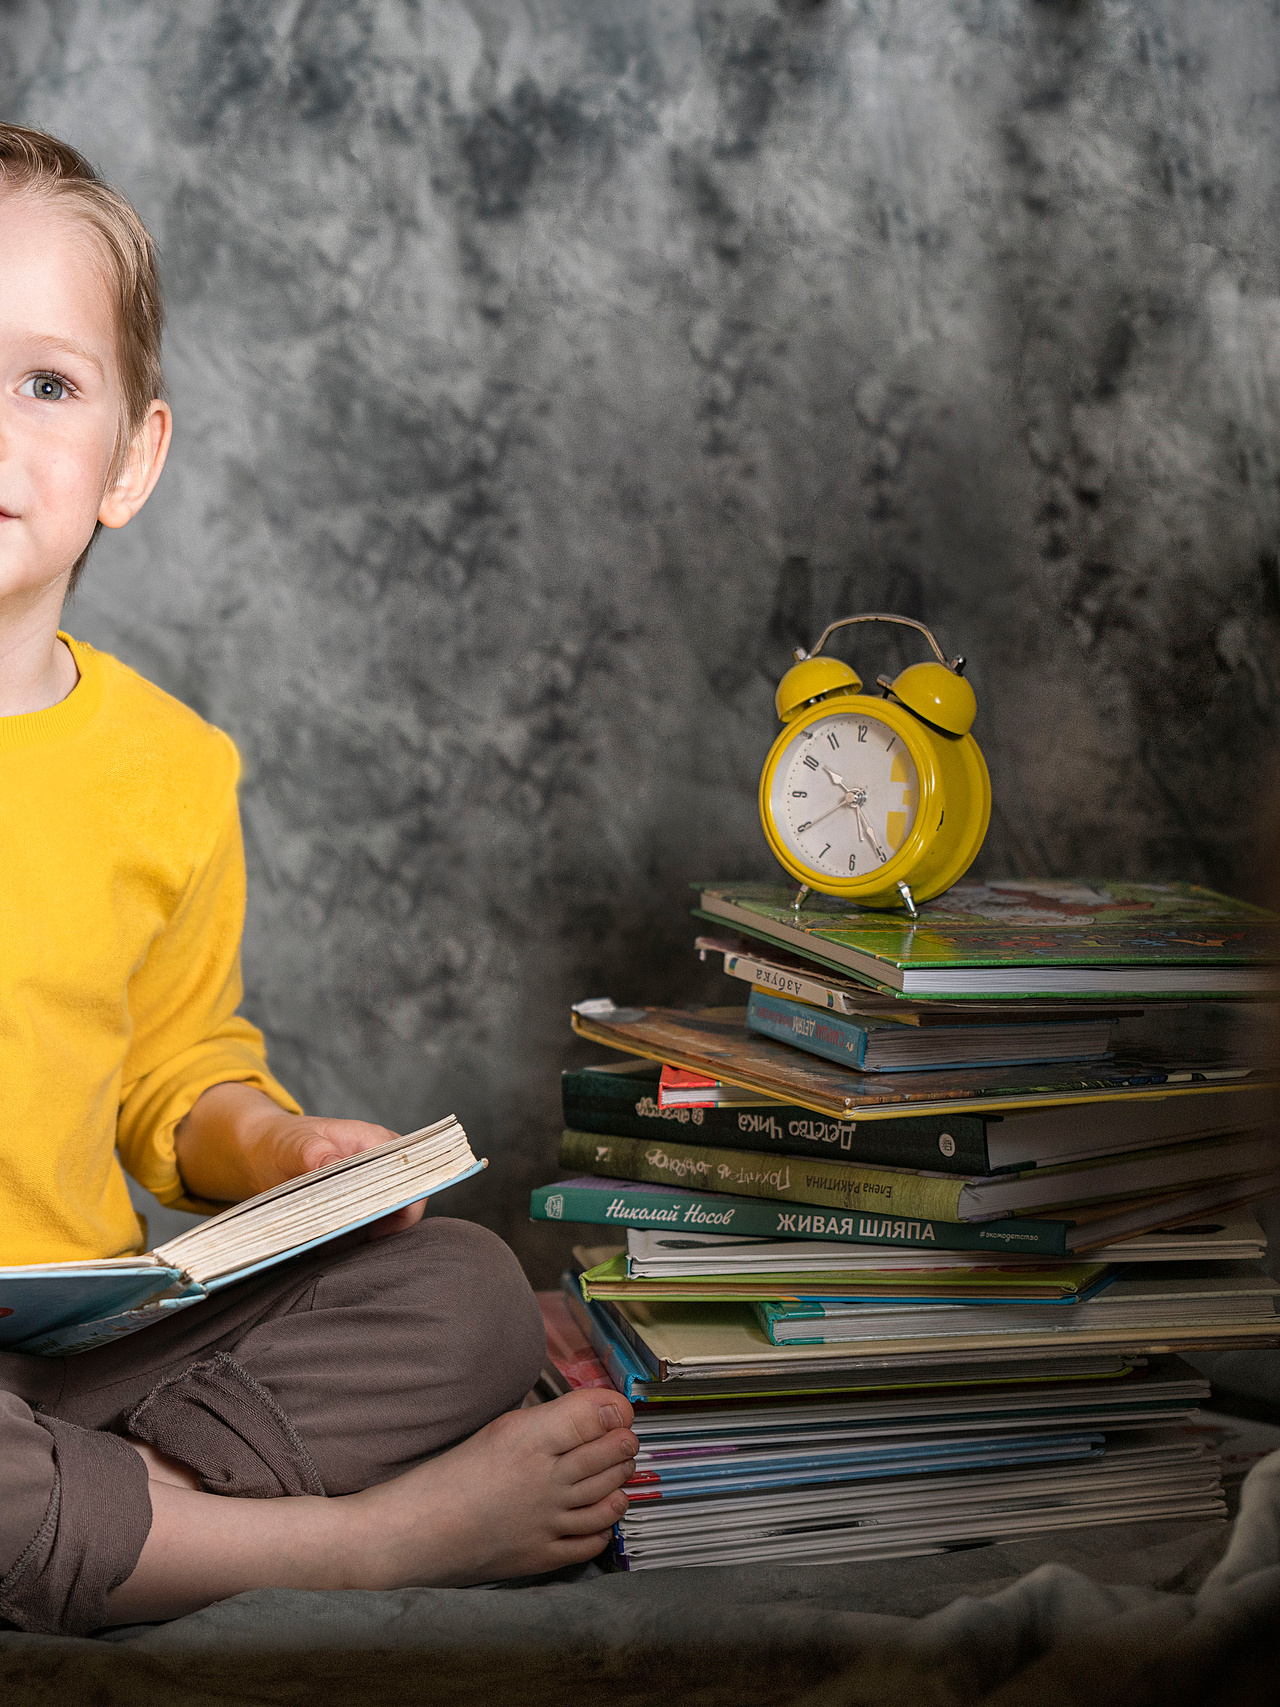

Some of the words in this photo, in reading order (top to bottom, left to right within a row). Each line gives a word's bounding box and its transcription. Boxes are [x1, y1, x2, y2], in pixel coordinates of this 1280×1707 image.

[826, 732, 840, 750] 11
[857, 725, 868, 743] 12
[885, 736, 896, 752] 1
[802, 755, 820, 771] 10
[792, 790, 808, 798] 9
[818, 843, 831, 858] 7
[848, 854, 856, 871] 6
[755, 969, 803, 996] Азбука
[792, 1016, 816, 1037] ДЕТЯМ
[737, 1112, 784, 1140] Чика
[788, 1119, 857, 1151] Детство
[717, 1163, 791, 1191] Похититель
[806, 1175, 862, 1194] РАКИТИНА
[862, 1182, 893, 1199] Елена
[605, 1198, 680, 1222] Николай
[682, 1203, 736, 1226] Носов
[776, 1213, 853, 1236] ЖИВАЯ
[858, 1219, 936, 1241] ШЛЯПА
